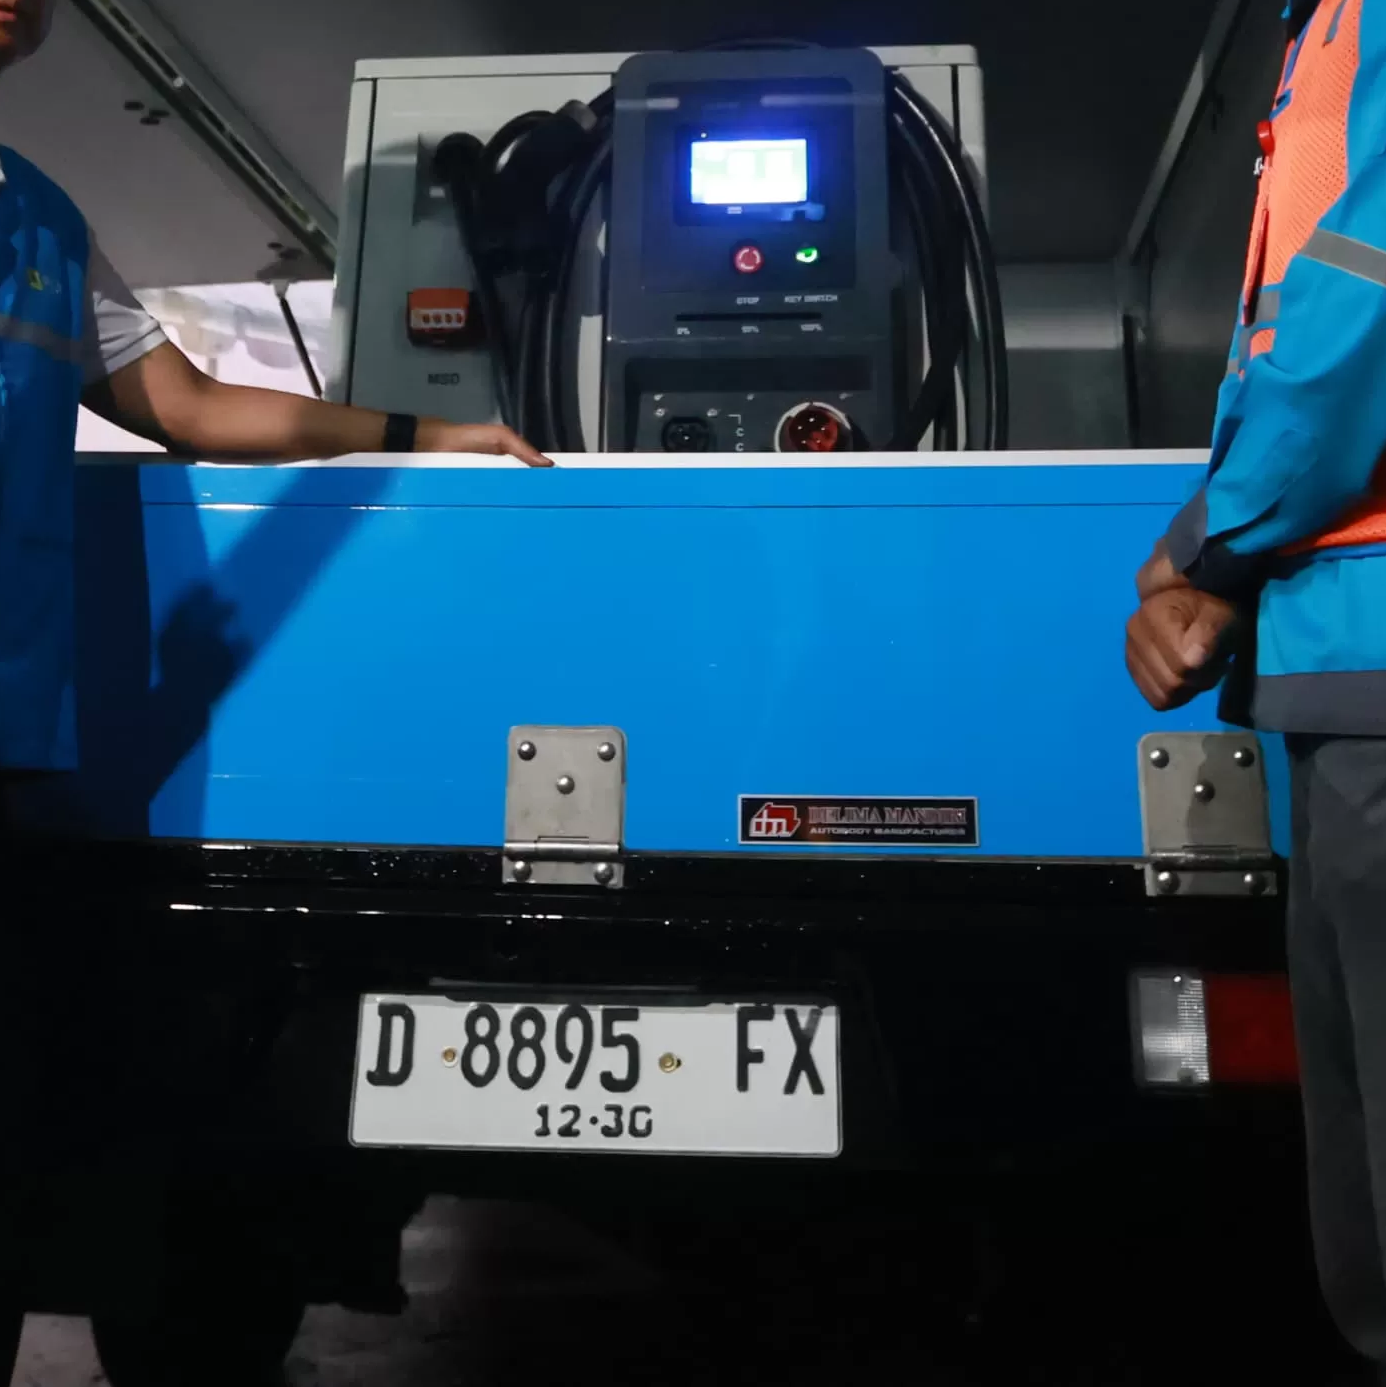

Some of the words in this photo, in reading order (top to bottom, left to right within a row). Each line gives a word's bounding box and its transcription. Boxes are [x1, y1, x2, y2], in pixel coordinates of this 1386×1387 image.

[808, 807, 883, 824] DELIMA
[366, 1002, 416, 1087] D
[460, 1002, 642, 1093] 8895
[735, 1005, 826, 1095] FX
